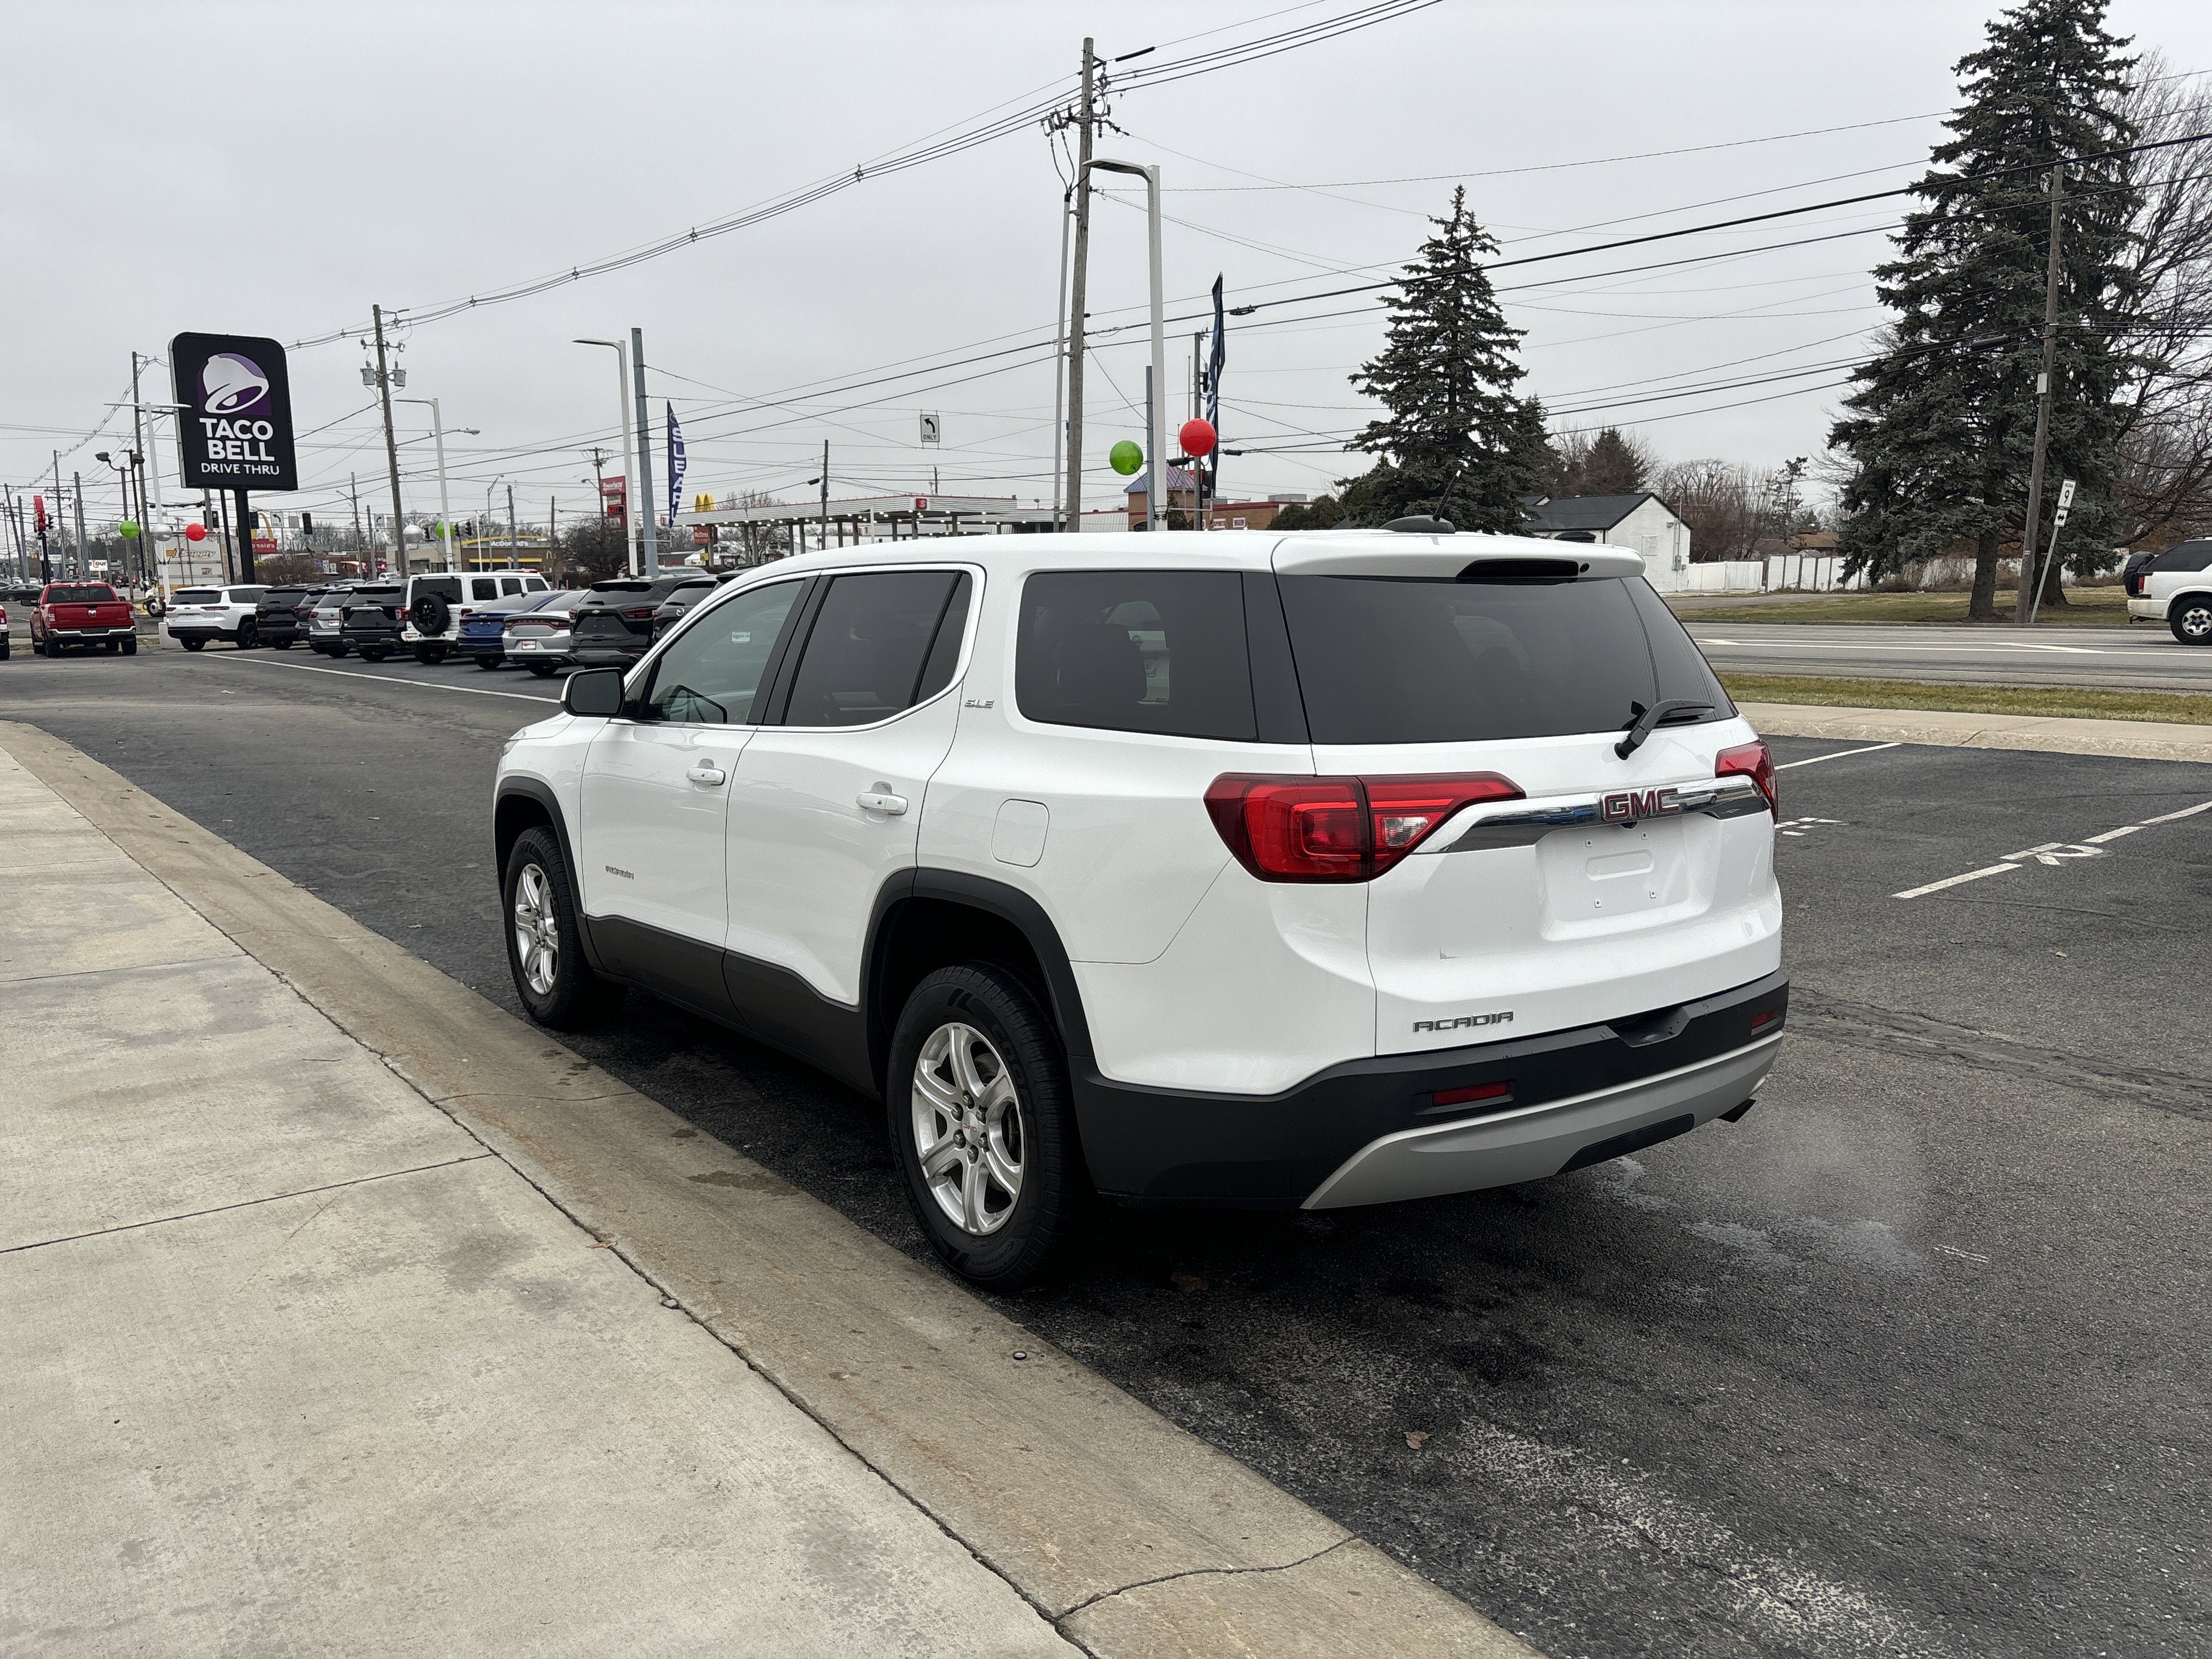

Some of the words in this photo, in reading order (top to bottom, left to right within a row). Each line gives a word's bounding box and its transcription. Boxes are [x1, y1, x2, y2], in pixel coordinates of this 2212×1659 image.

[199, 417, 273, 440] TACO
[207, 439, 275, 461] BELL
[201, 462, 241, 473] DRIVE
[243, 464, 280, 475] THRU
[2064, 489, 2070, 505] 9
[964, 698, 995, 708] SLE
[1602, 787, 1680, 821] GMC
[1413, 1009, 1514, 1032] ACADIA
[963, 1122, 977, 1132] GMC
